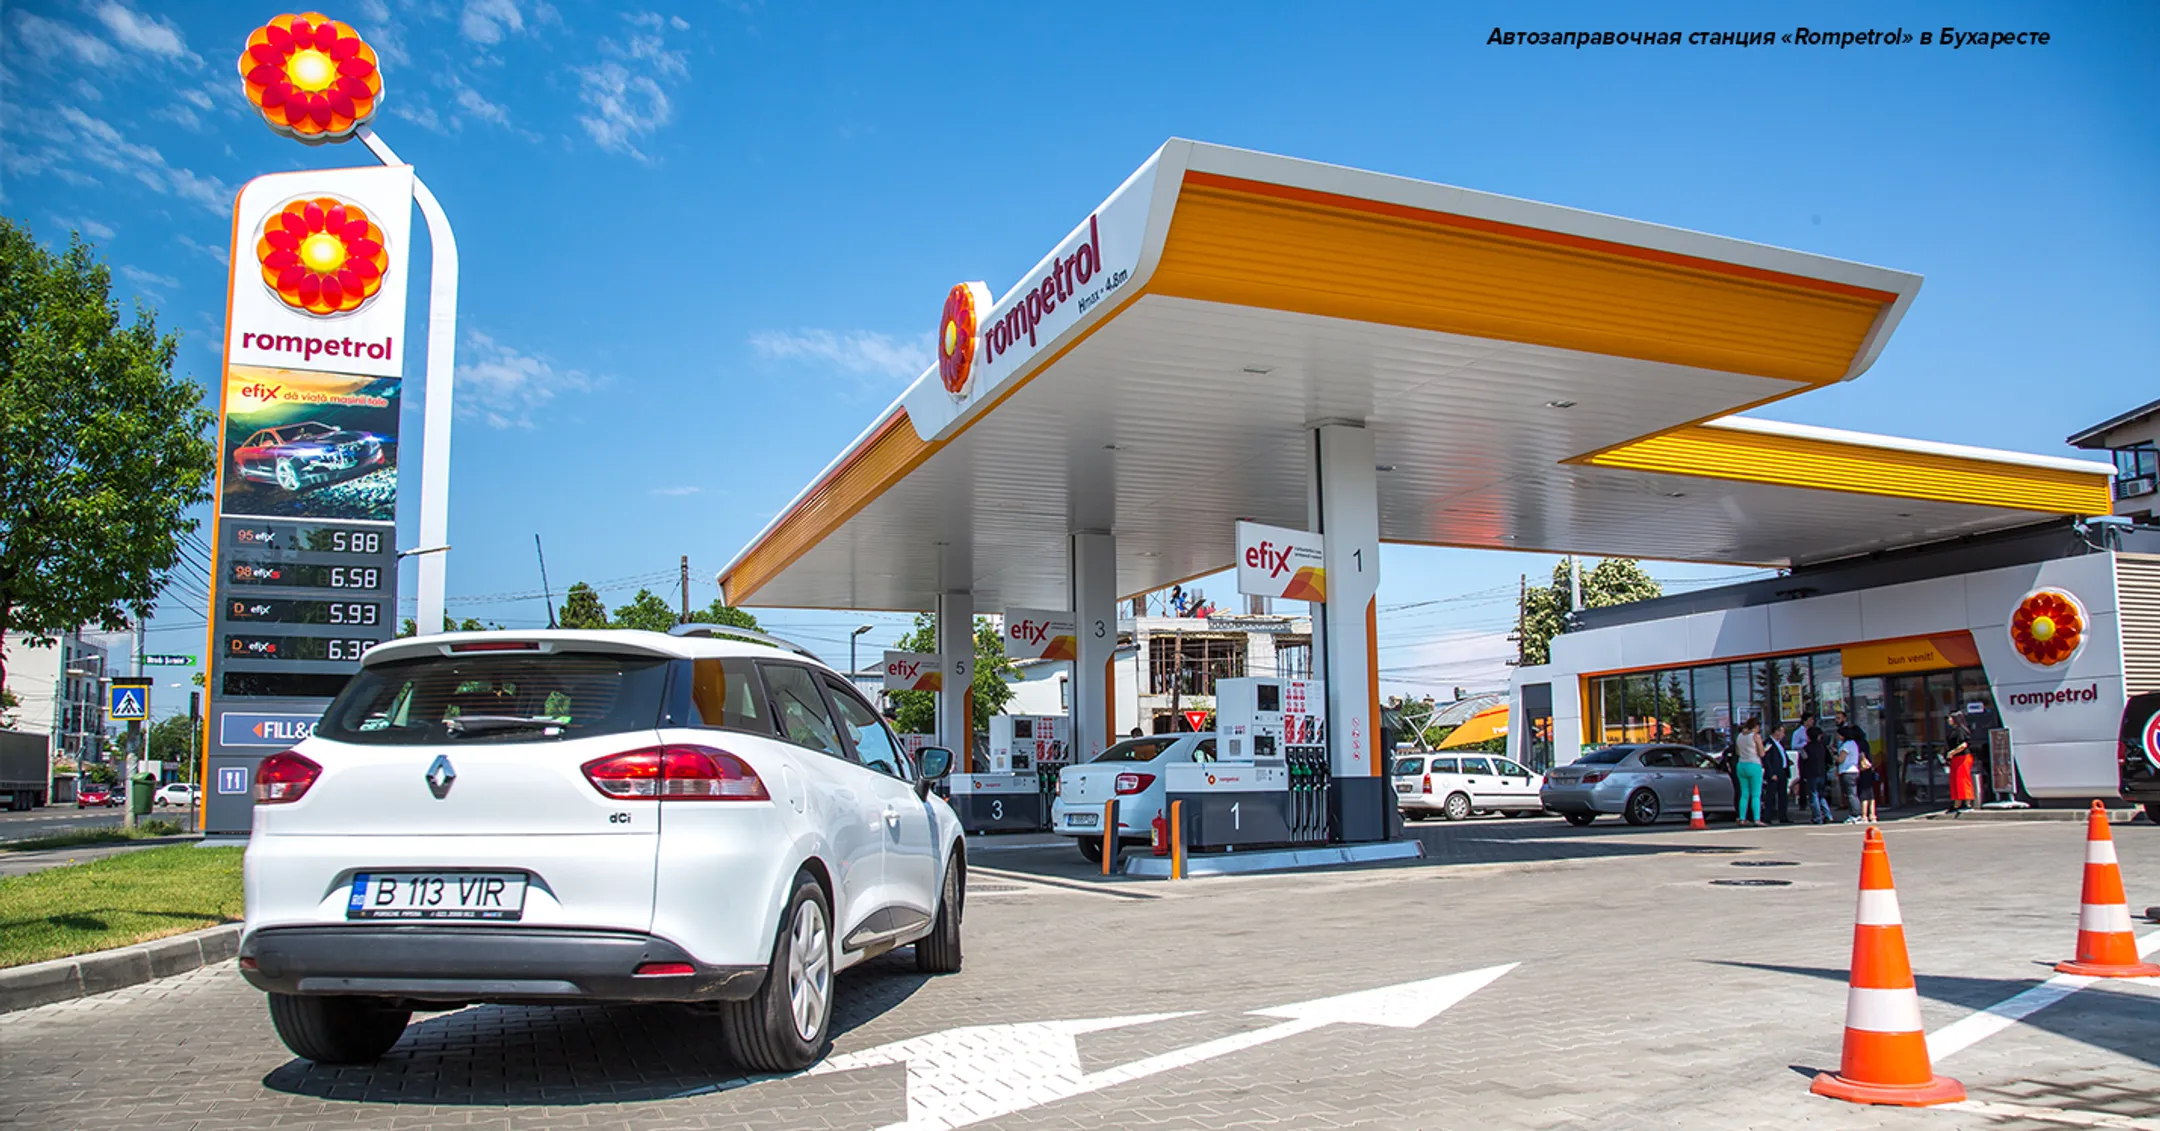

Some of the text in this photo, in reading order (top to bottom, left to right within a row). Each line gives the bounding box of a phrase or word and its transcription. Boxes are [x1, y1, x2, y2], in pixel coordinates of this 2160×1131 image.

[984, 213, 1101, 364] rompetrol
[1105, 269, 1129, 291] 4.8m
[242, 332, 392, 361] rompetrol
[242, 384, 281, 402] efix
[237, 529, 254, 541] 95
[1245, 540, 1294, 579] efix
[1353, 548, 1362, 573] 1
[331, 567, 378, 588] 6.58
[233, 602, 245, 614] D
[329, 603, 376, 624] 5.93
[1011, 619, 1050, 646] efix
[1095, 620, 1106, 638] 3
[231, 639, 243, 651] D
[888, 660, 920, 680] efix
[956, 661, 966, 676] 5
[1887, 655, 1906, 665] bun
[2009, 683, 2098, 709] rompetrol
[609, 812, 632, 824] dCi
[991, 800, 1003, 820] 3
[1230, 802, 1239, 830] 1
[375, 878, 397, 906] B
[408, 877, 444, 906] 113
[459, 877, 505, 906] VIR
